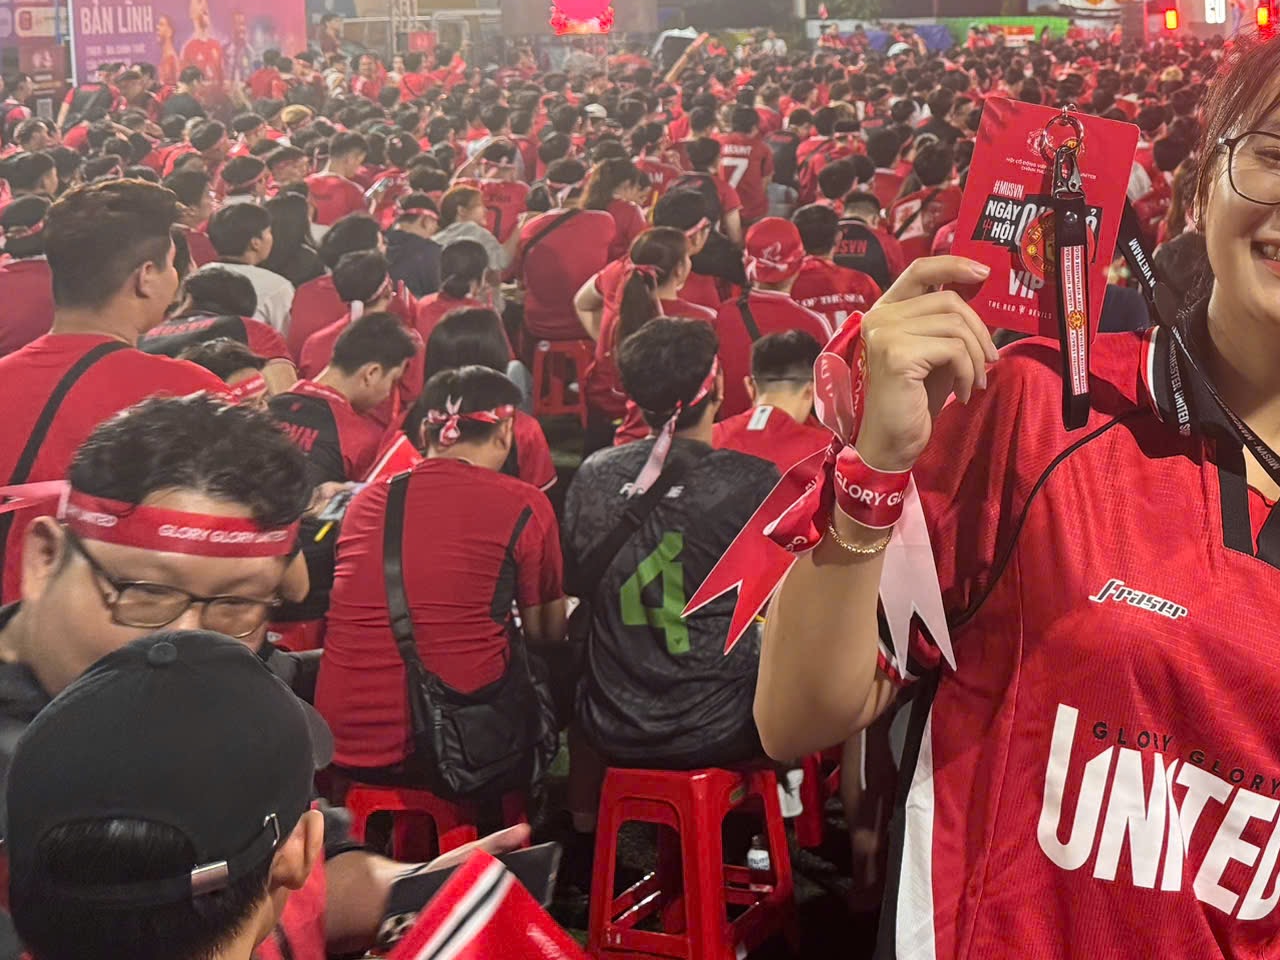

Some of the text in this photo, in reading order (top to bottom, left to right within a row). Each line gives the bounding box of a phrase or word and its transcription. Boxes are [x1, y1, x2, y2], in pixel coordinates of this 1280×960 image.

[118, 0, 153, 34] LĨNH
[722, 157, 749, 188] 7
[993, 180, 1024, 198] #MUSVN
[985, 200, 1021, 222] NGÀY
[991, 222, 1015, 244] HỘI
[1128, 238, 1152, 279] VIETNAM
[1009, 268, 1045, 300] VIP
[988, 300, 1052, 320] THE RED DEVILS
[1174, 390, 1190, 425] UNITED
[834, 472, 885, 507] GLORY
[158, 524, 209, 541] GLORY
[209, 526, 256, 543] GLORY
[620, 531, 691, 655] 4
